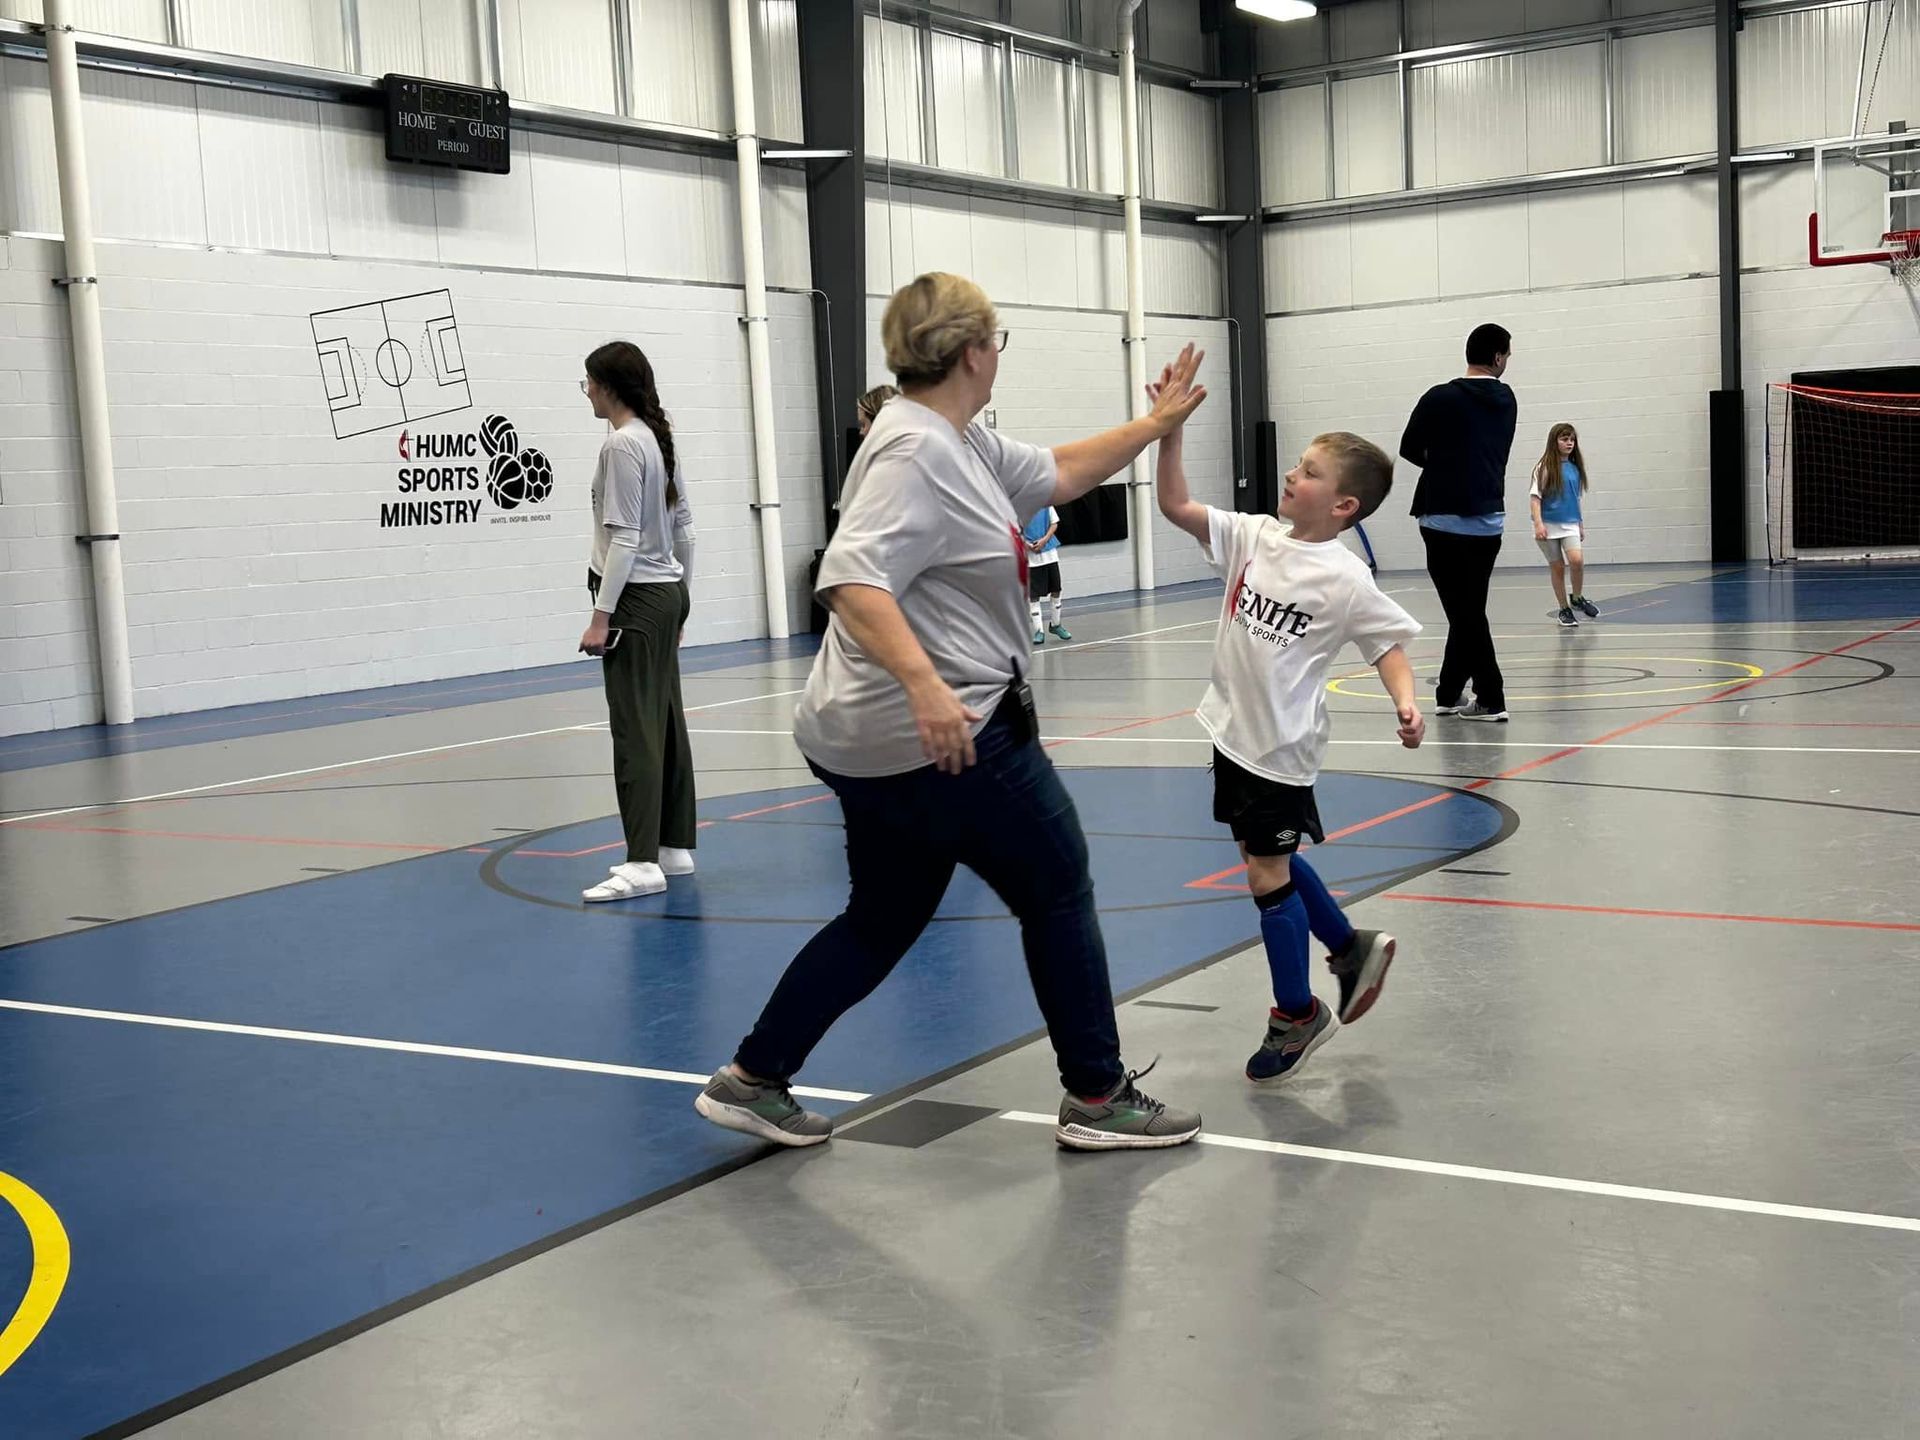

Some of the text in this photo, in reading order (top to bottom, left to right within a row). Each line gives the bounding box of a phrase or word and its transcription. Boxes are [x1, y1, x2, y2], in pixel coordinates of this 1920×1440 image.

[398, 111, 437, 130] HOME
[468, 121, 507, 140] GUEST
[437, 139, 470, 154] PERIOD
[416, 433, 477, 458] HUMC
[398, 466, 480, 493] SPORTS
[380, 499, 482, 528] MINISTRY
[1251, 626, 1289, 648] SPORTS
